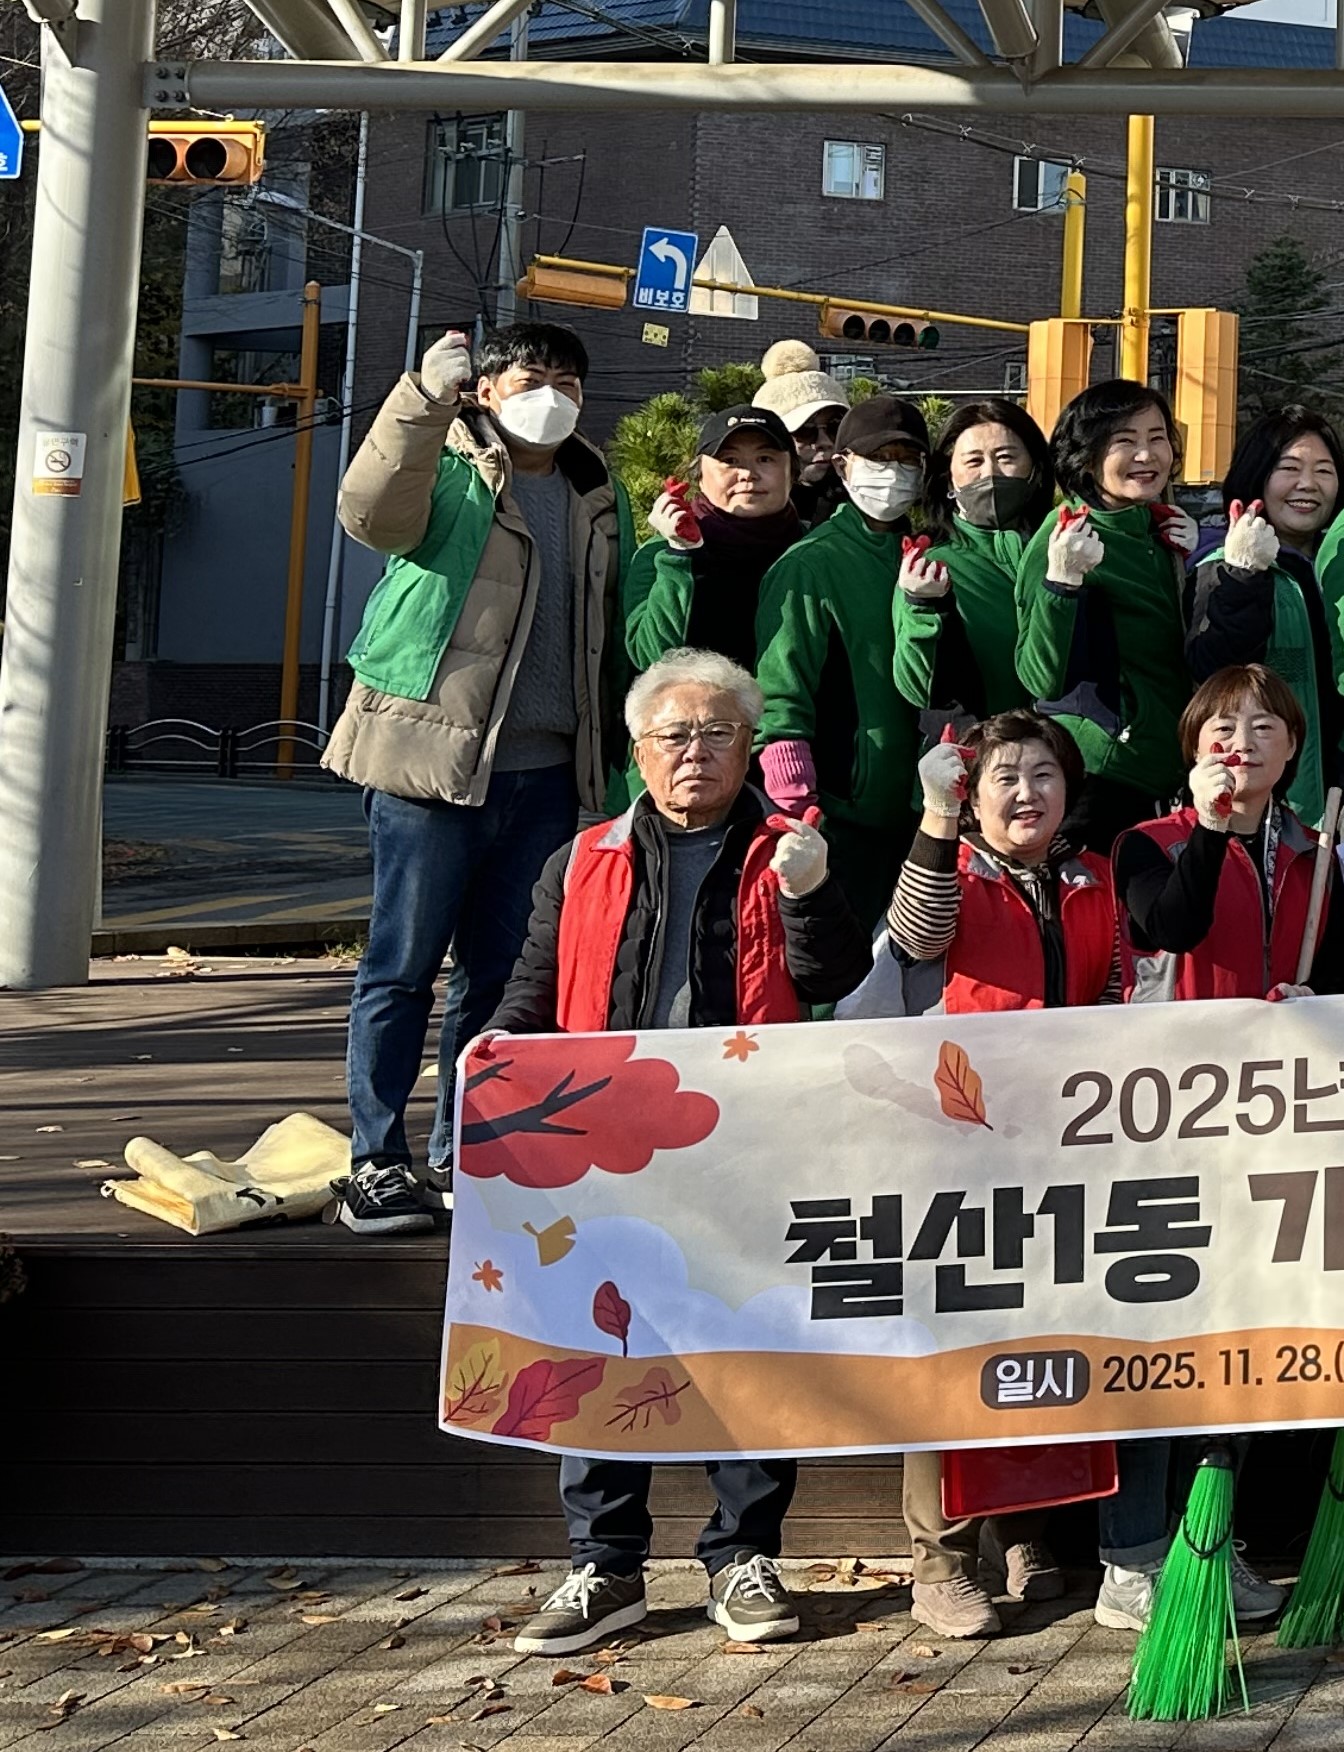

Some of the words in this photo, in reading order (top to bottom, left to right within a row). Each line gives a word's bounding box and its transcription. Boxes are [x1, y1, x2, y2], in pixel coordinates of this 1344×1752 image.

[638, 287, 686, 308] 비보호
[784, 1175, 1213, 1321] 철산1동
[996, 1357, 1074, 1403] 일시
[1102, 1351, 1206, 1393] 2025.
[1219, 1348, 1264, 1386] 11.
